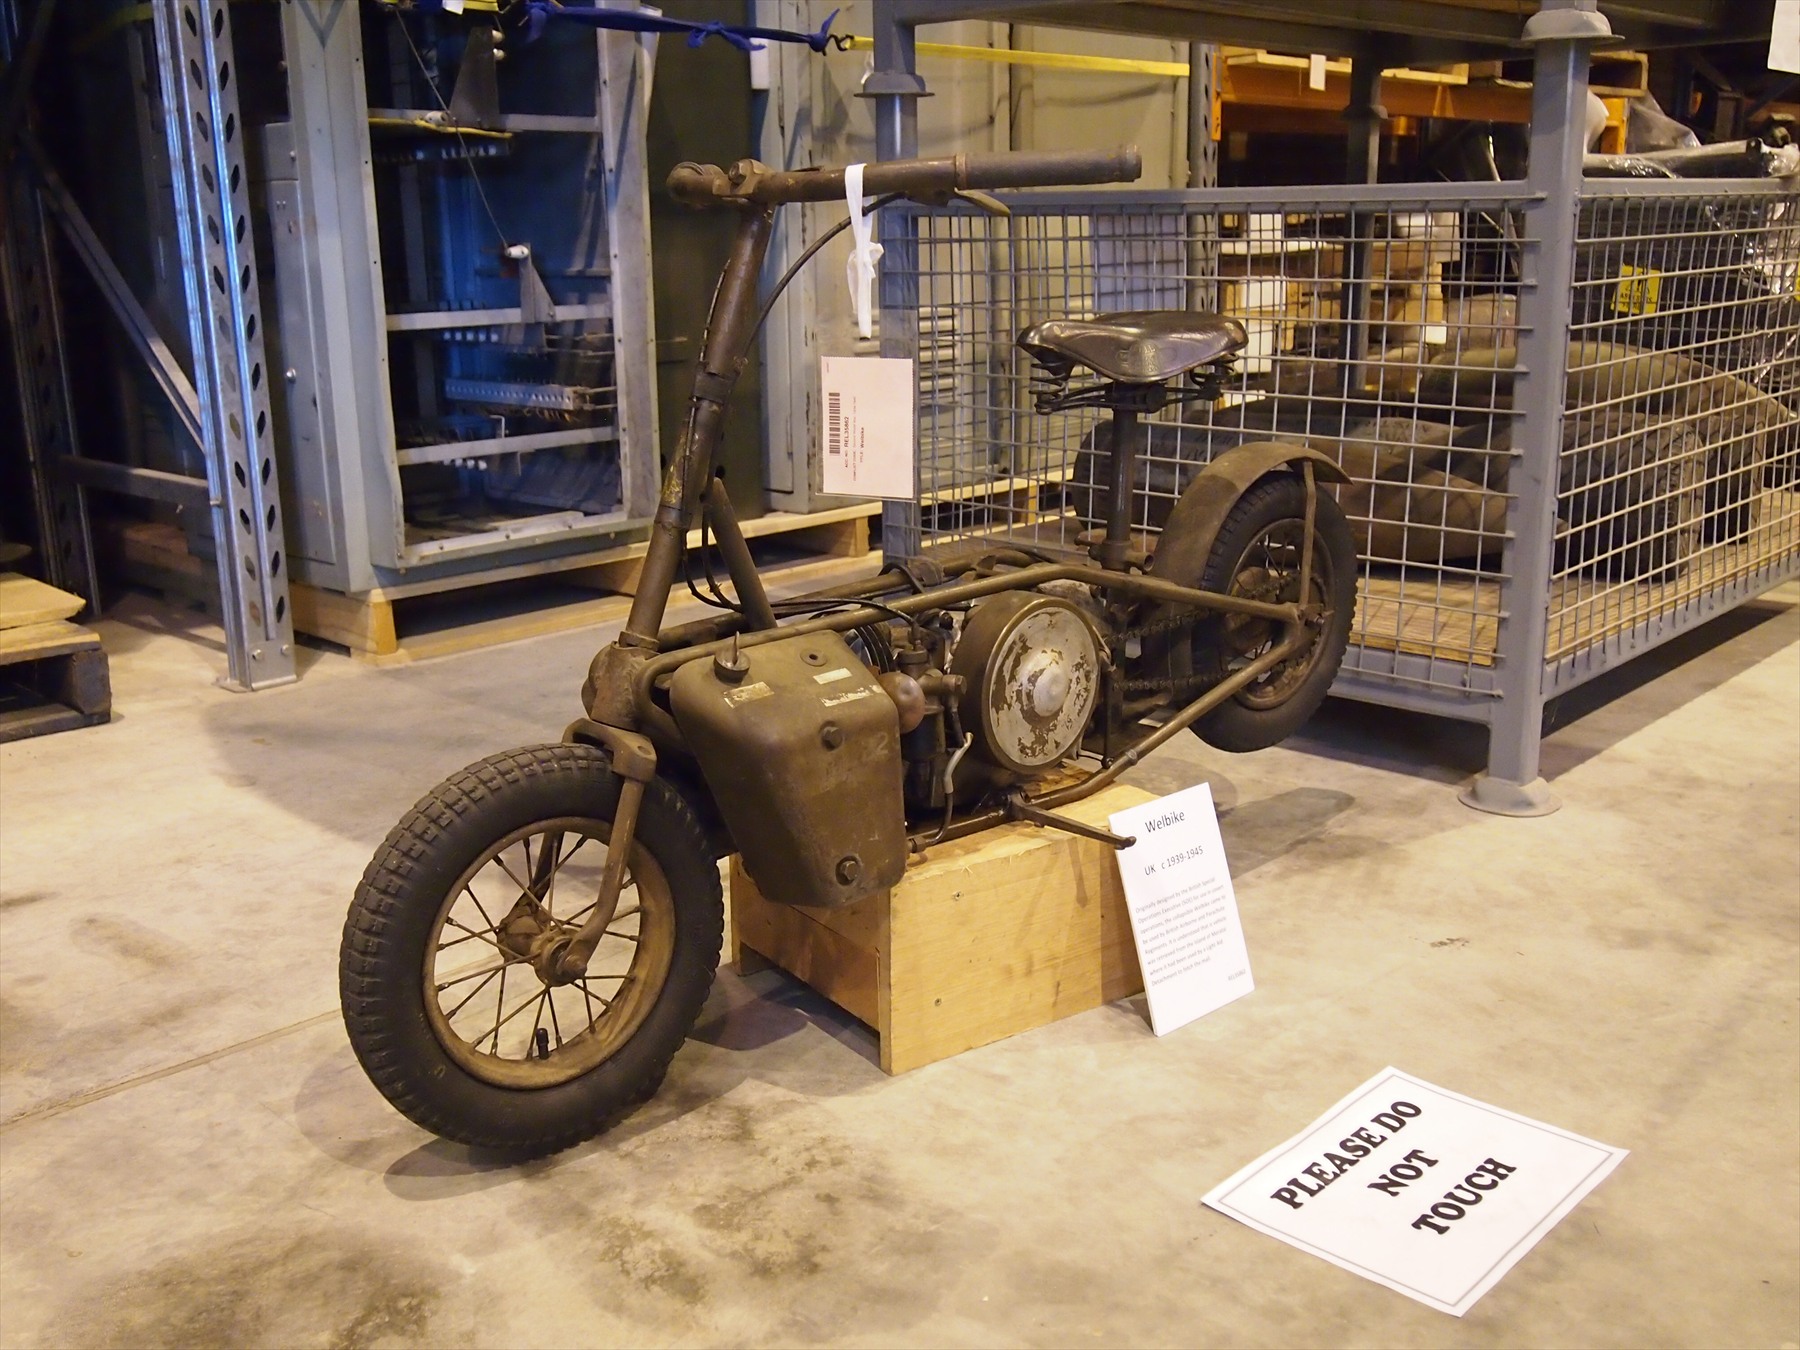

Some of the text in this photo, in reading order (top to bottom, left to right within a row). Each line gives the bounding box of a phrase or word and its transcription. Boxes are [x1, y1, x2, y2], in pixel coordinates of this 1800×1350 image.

[1145, 811, 1185, 833] Welbike
[1144, 864, 1156, 876] UK
[1167, 845, 1204, 867] 1939-1945
[1270, 1101, 1422, 1209] PLEASE DO
[1366, 1149, 1439, 1197] NOT
[1411, 1157, 1517, 1235] TOUCH
